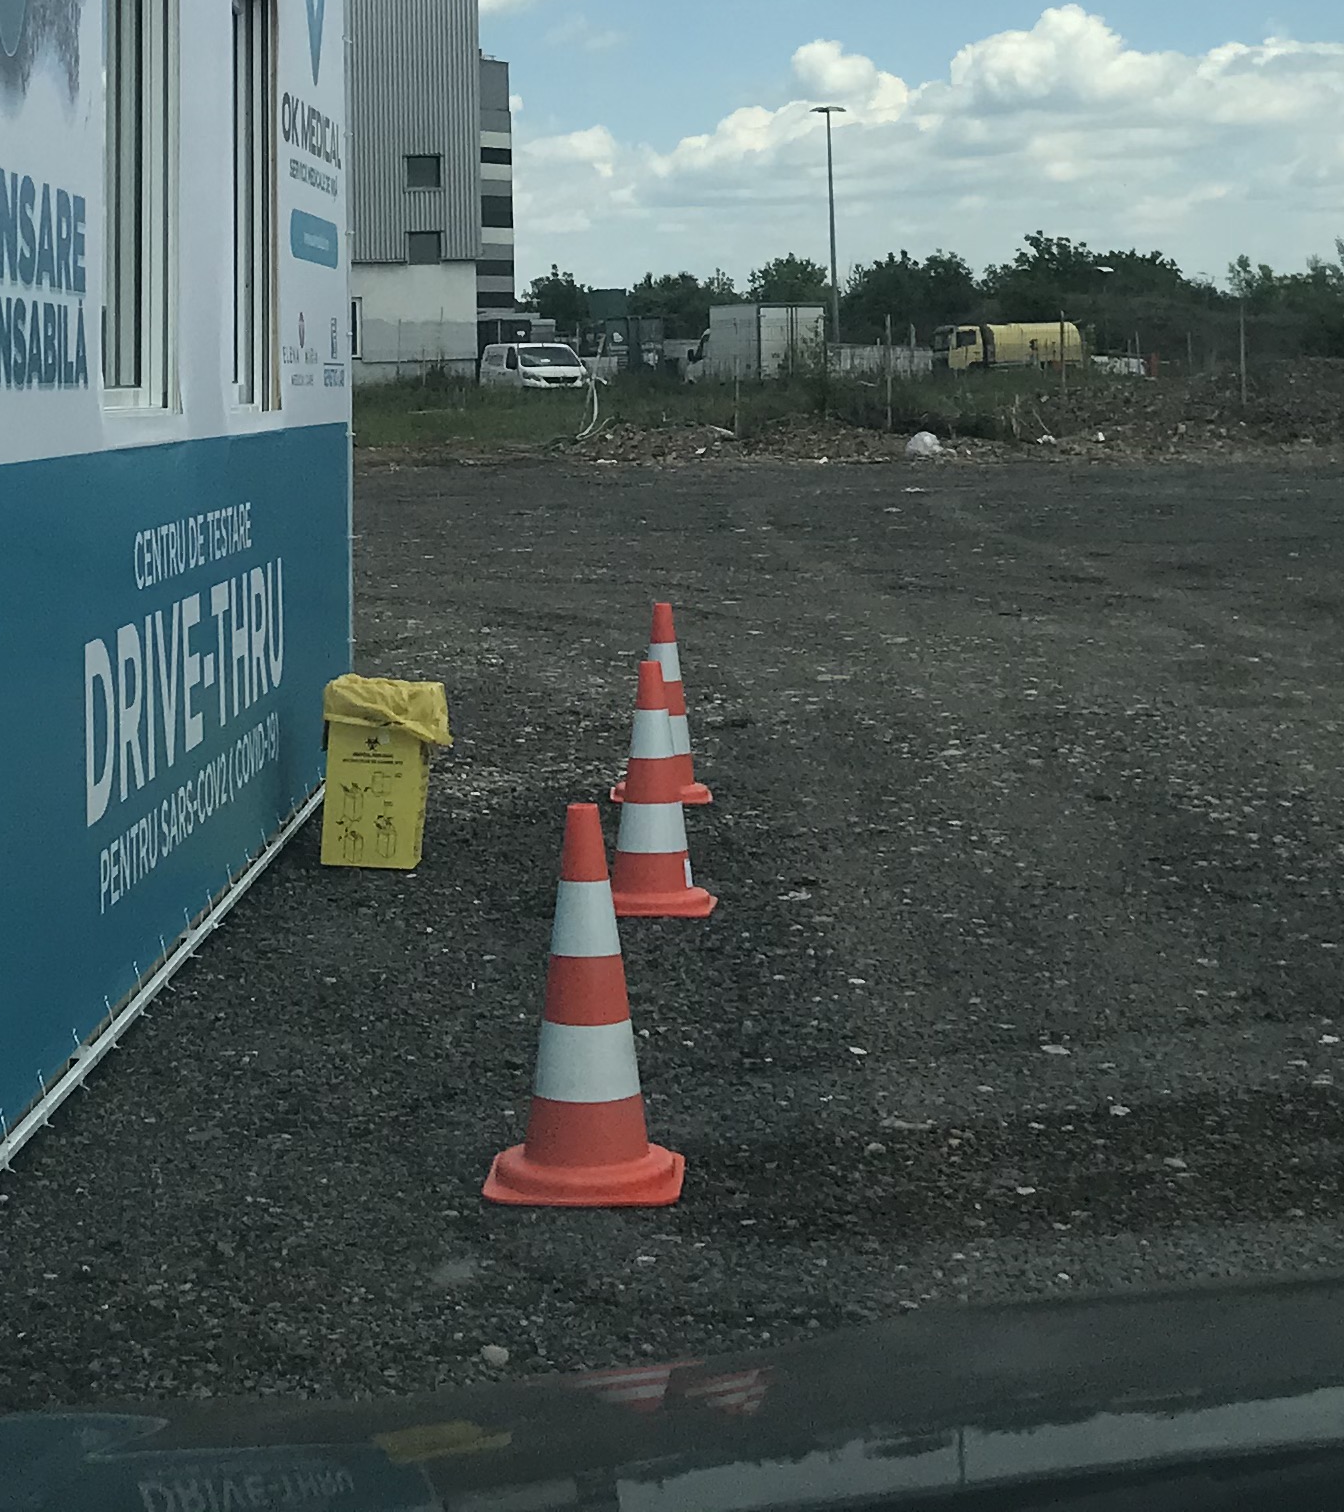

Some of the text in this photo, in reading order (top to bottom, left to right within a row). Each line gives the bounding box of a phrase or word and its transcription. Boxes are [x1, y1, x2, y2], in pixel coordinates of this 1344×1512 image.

[282, 92, 341, 170] OK MEDICAL
[134, 502, 252, 590] CENTRU DE TESTARE
[84, 557, 284, 828] DRIVE-THRU
[100, 808, 157, 915] PENTRU
[161, 750, 228, 858] SARS-COV2
